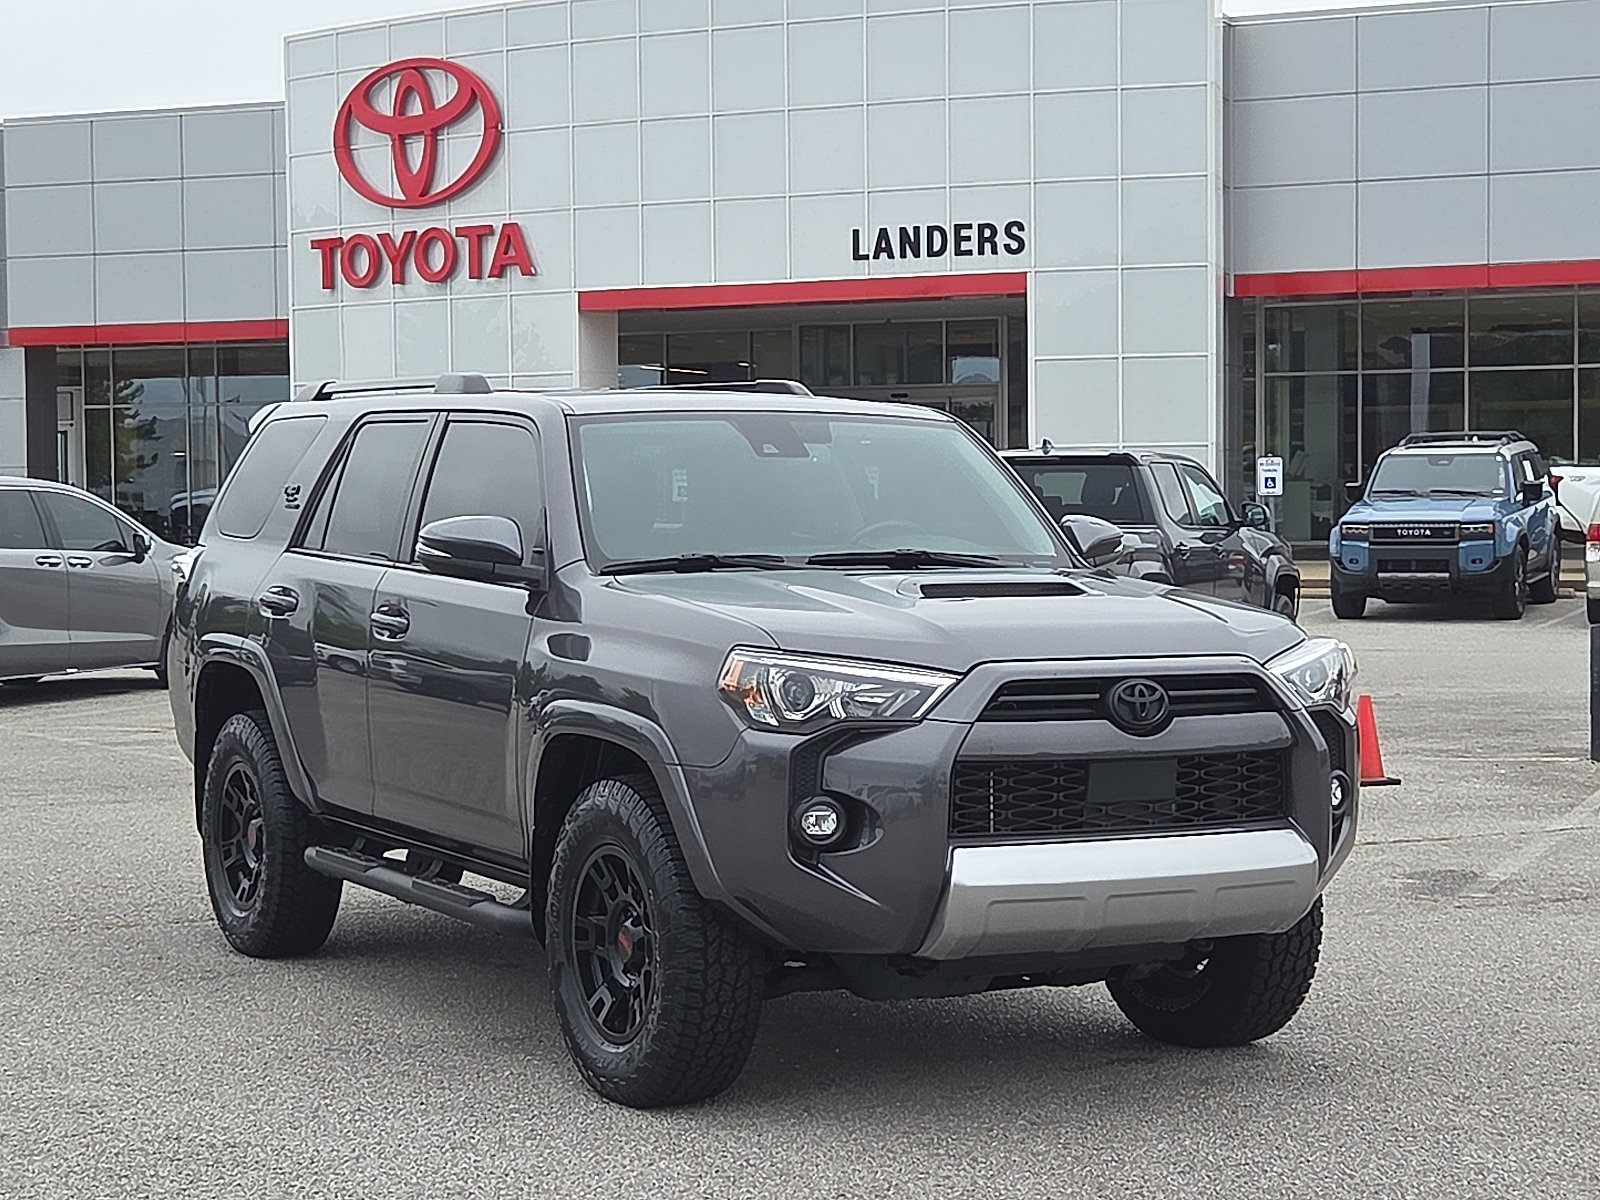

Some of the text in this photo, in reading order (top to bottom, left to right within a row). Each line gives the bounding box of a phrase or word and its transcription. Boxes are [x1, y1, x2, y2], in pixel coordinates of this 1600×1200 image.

[311, 222, 536, 290] TOYOTA
[852, 220, 1026, 261] LANDERS
[1396, 528, 1431, 536] TOYOTA
